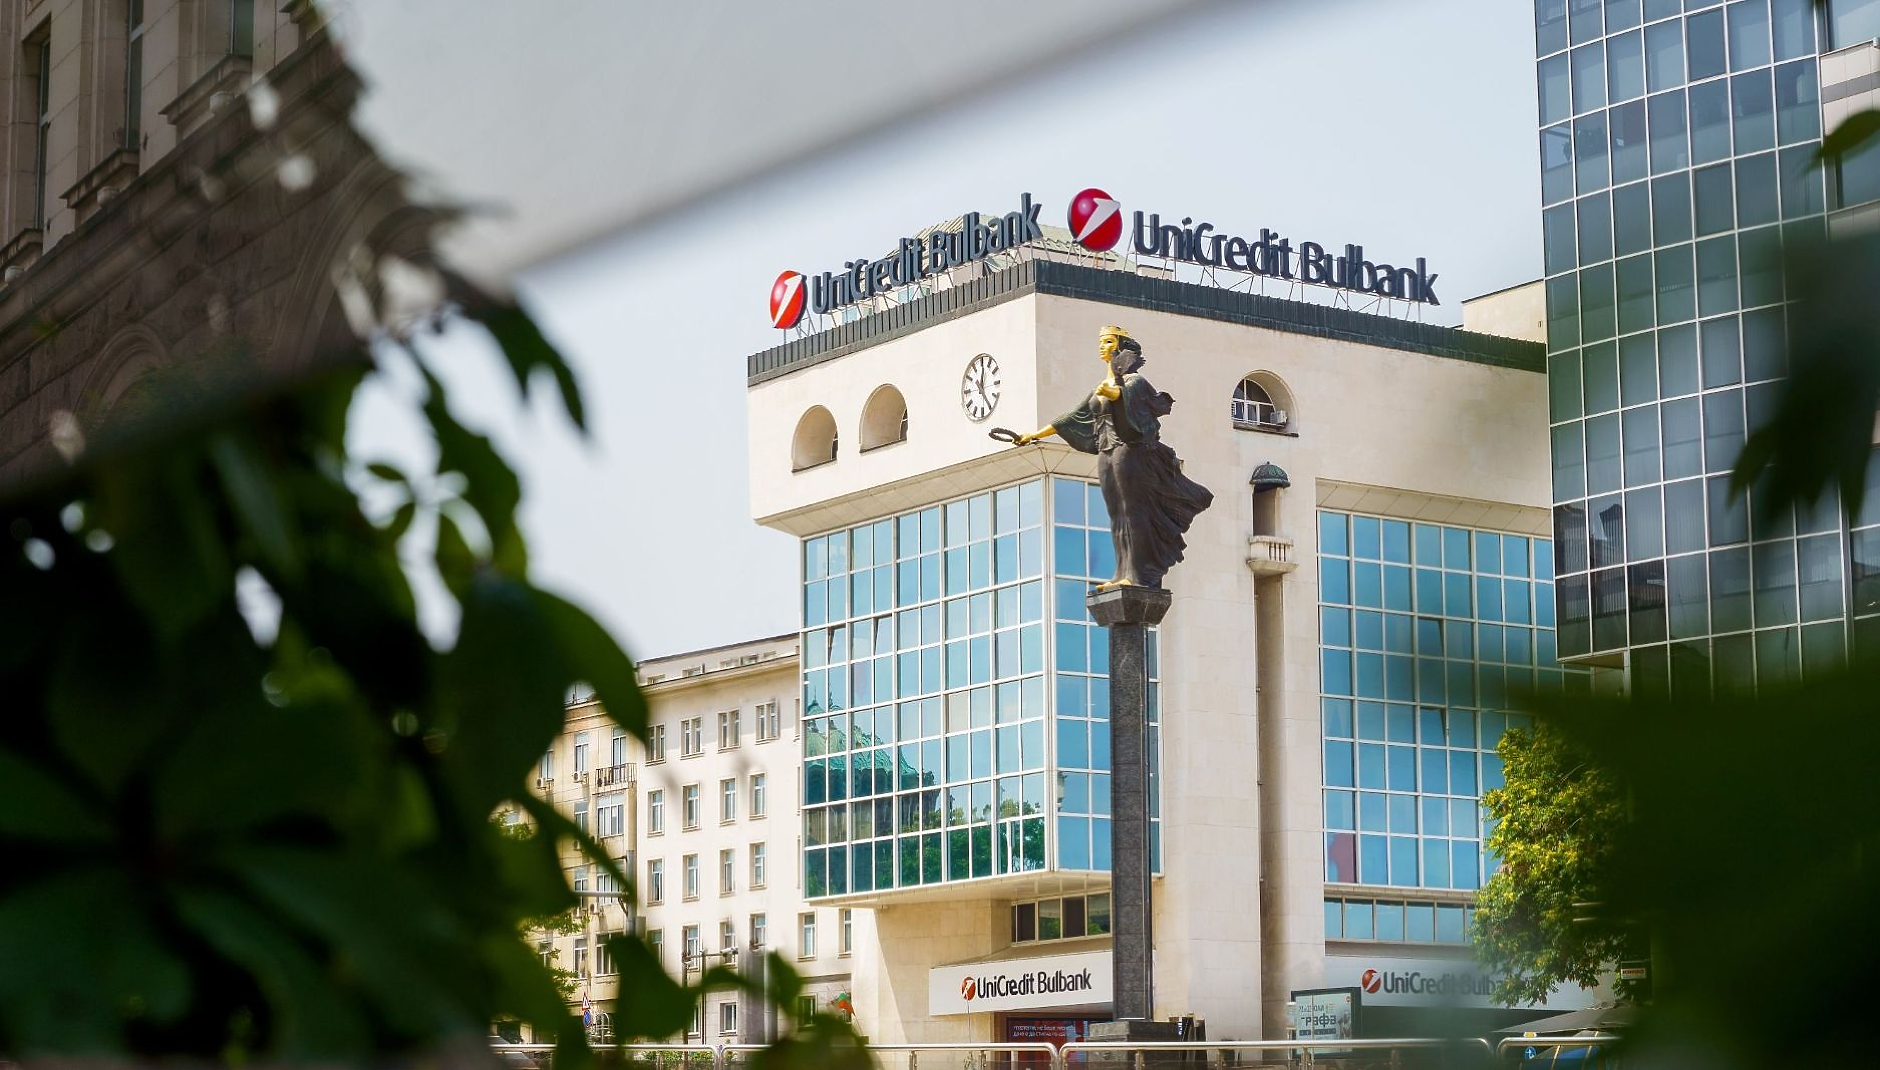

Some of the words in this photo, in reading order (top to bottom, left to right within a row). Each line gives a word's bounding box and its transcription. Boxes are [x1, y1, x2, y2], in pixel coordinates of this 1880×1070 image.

[812, 237, 923, 315] UniCredit
[928, 191, 1044, 275] Bulbank
[1133, 210, 1294, 280] UniCredit
[1299, 239, 1441, 306] Bulbank
[977, 972, 1035, 999] UniCredit
[1037, 967, 1092, 994] Bulbank
